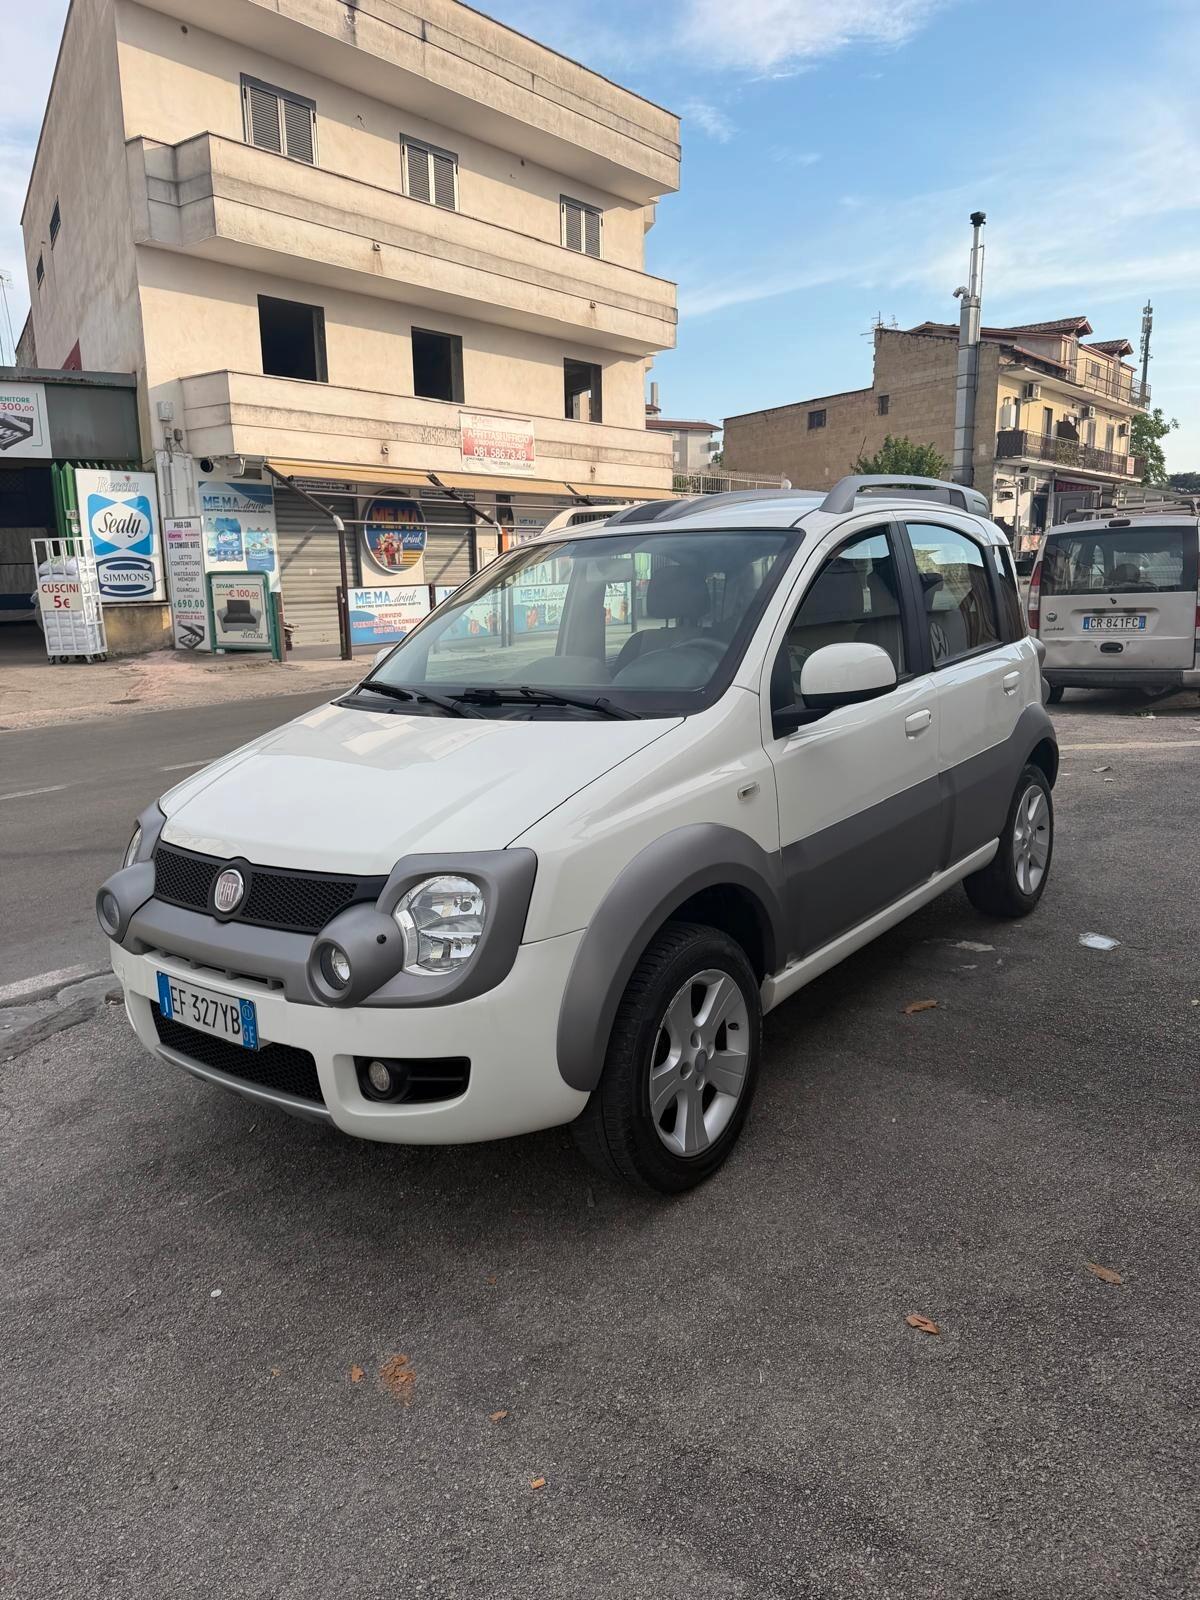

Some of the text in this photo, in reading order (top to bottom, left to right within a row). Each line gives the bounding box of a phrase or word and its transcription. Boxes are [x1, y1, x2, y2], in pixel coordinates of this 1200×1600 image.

[98, 512, 142, 538] Sealy
[103, 573, 150, 582] SIMMONS
[41, 584, 80, 594] CUSCINI
[1090, 618, 1103, 628] CR
[1106, 617, 1138, 628] 841FC
[220, 882, 238, 902] FIAT
[170, 985, 187, 1016] EF
[191, 993, 241, 1035] 327YB
